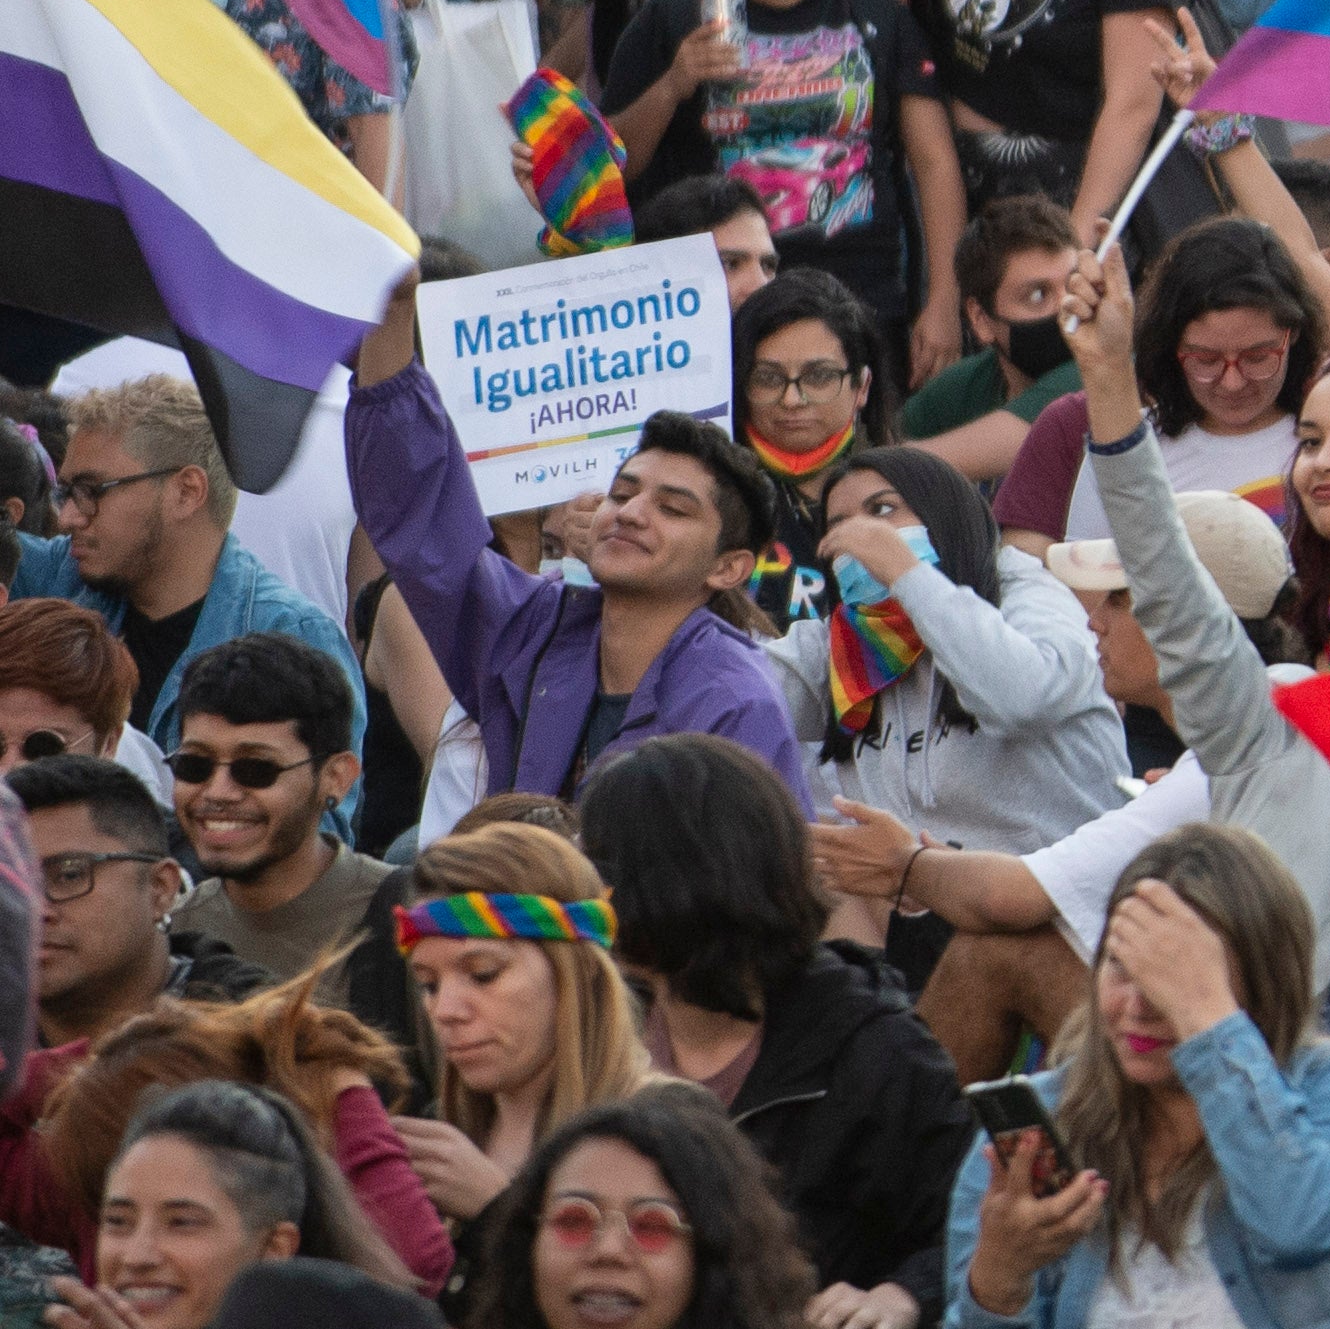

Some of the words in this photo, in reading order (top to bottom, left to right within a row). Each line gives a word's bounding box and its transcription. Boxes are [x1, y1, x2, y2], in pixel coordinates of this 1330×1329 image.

[454, 279, 701, 358] Matrimonio
[473, 331, 691, 413] Igualitario
[530, 388, 638, 434] ¡AHORA!
[515, 458, 597, 484] MOVILH
